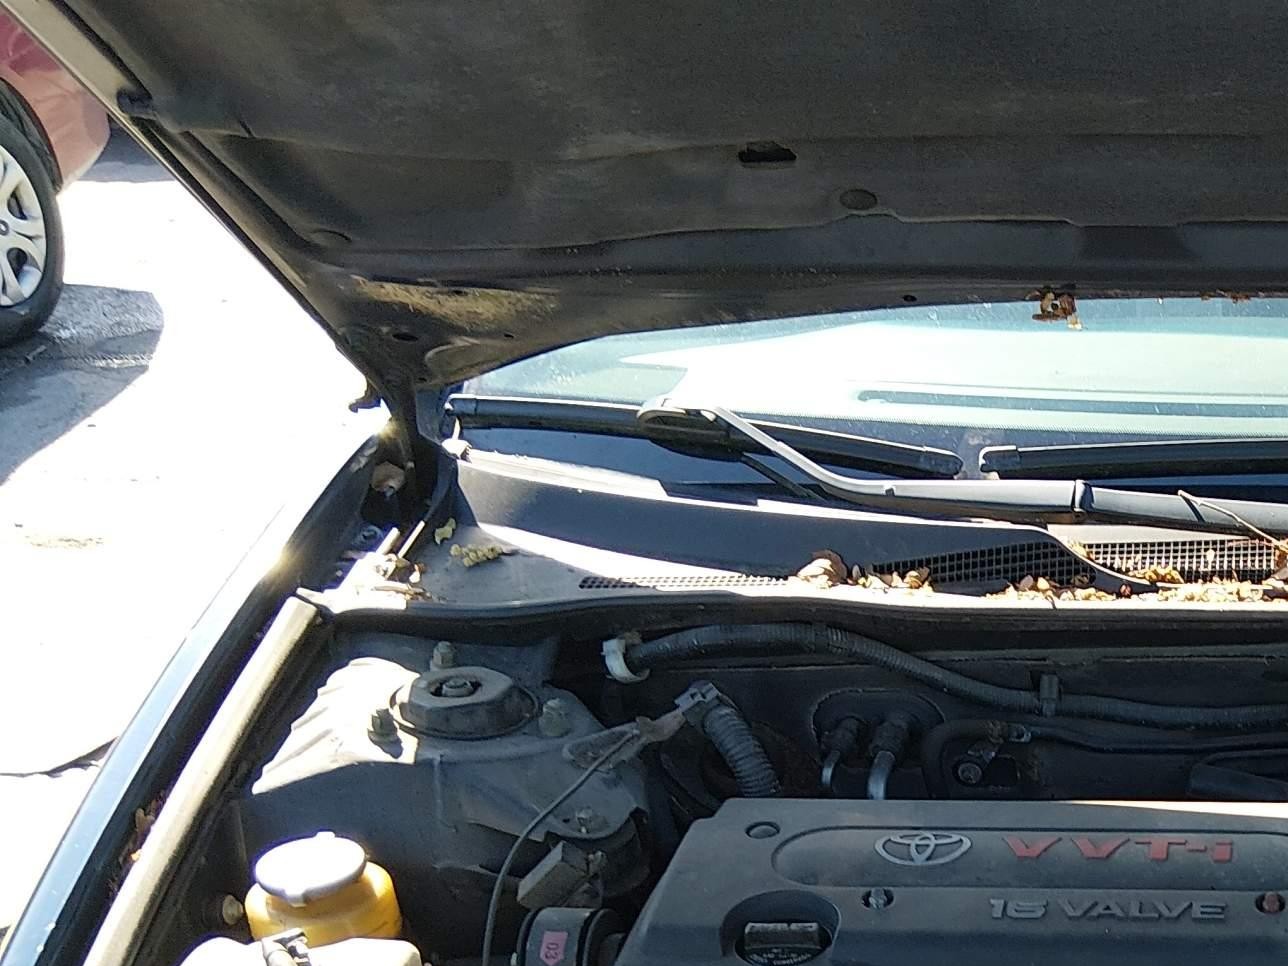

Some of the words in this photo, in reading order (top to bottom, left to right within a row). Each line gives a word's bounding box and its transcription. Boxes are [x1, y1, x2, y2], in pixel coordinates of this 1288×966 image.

[1003, 837, 1233, 863] VVT-i
[989, 898, 1049, 919] 16
[1058, 898, 1227, 920] VALVE
